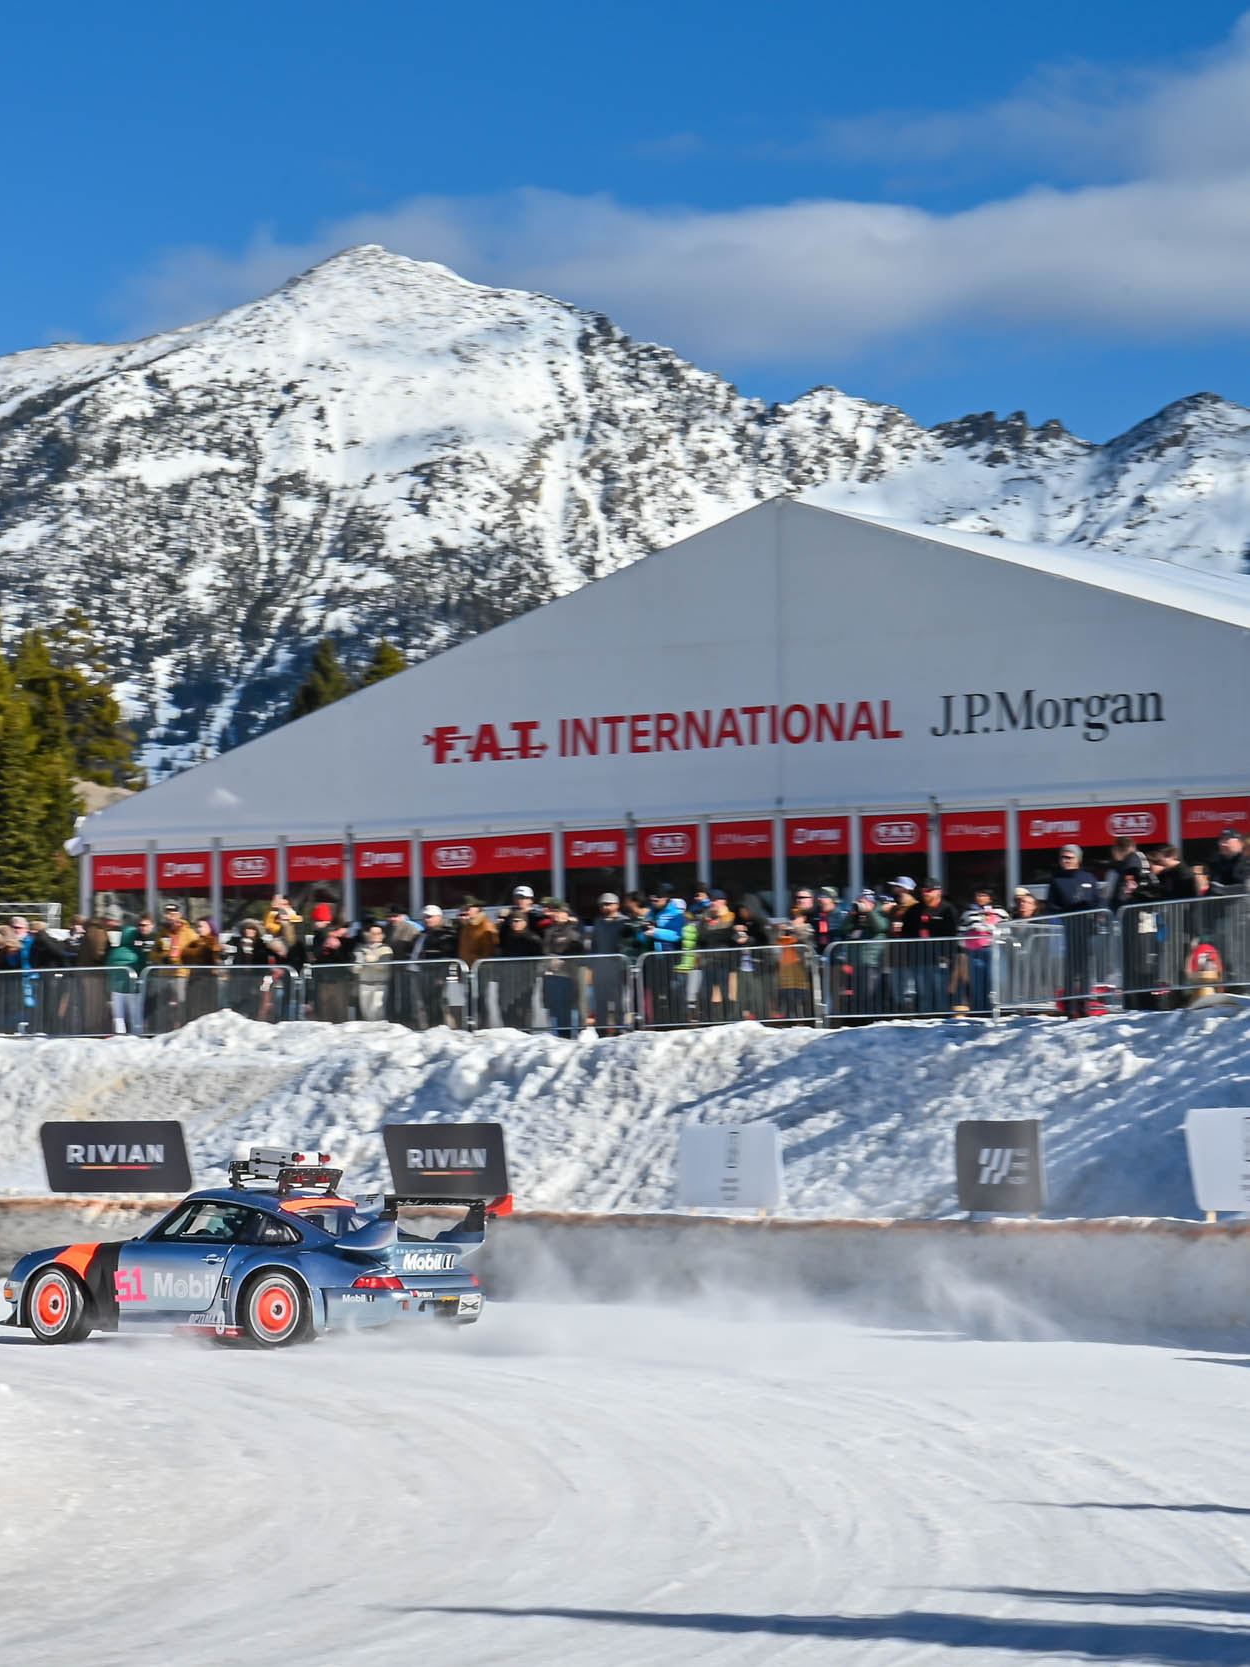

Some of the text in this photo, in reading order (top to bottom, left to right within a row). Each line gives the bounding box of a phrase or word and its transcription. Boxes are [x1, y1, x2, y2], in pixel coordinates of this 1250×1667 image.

[930, 690, 1166, 742] J.P.Morgan
[558, 700, 903, 757] INTERNATIONAL
[66, 1144, 165, 1163] RIVIAN
[406, 1148, 487, 1169] RIVIAN
[402, 1253, 443, 1270] Mobil
[114, 1266, 148, 1302] 51
[153, 1272, 216, 1298] Mobil
[342, 1294, 366, 1303] Mobil
